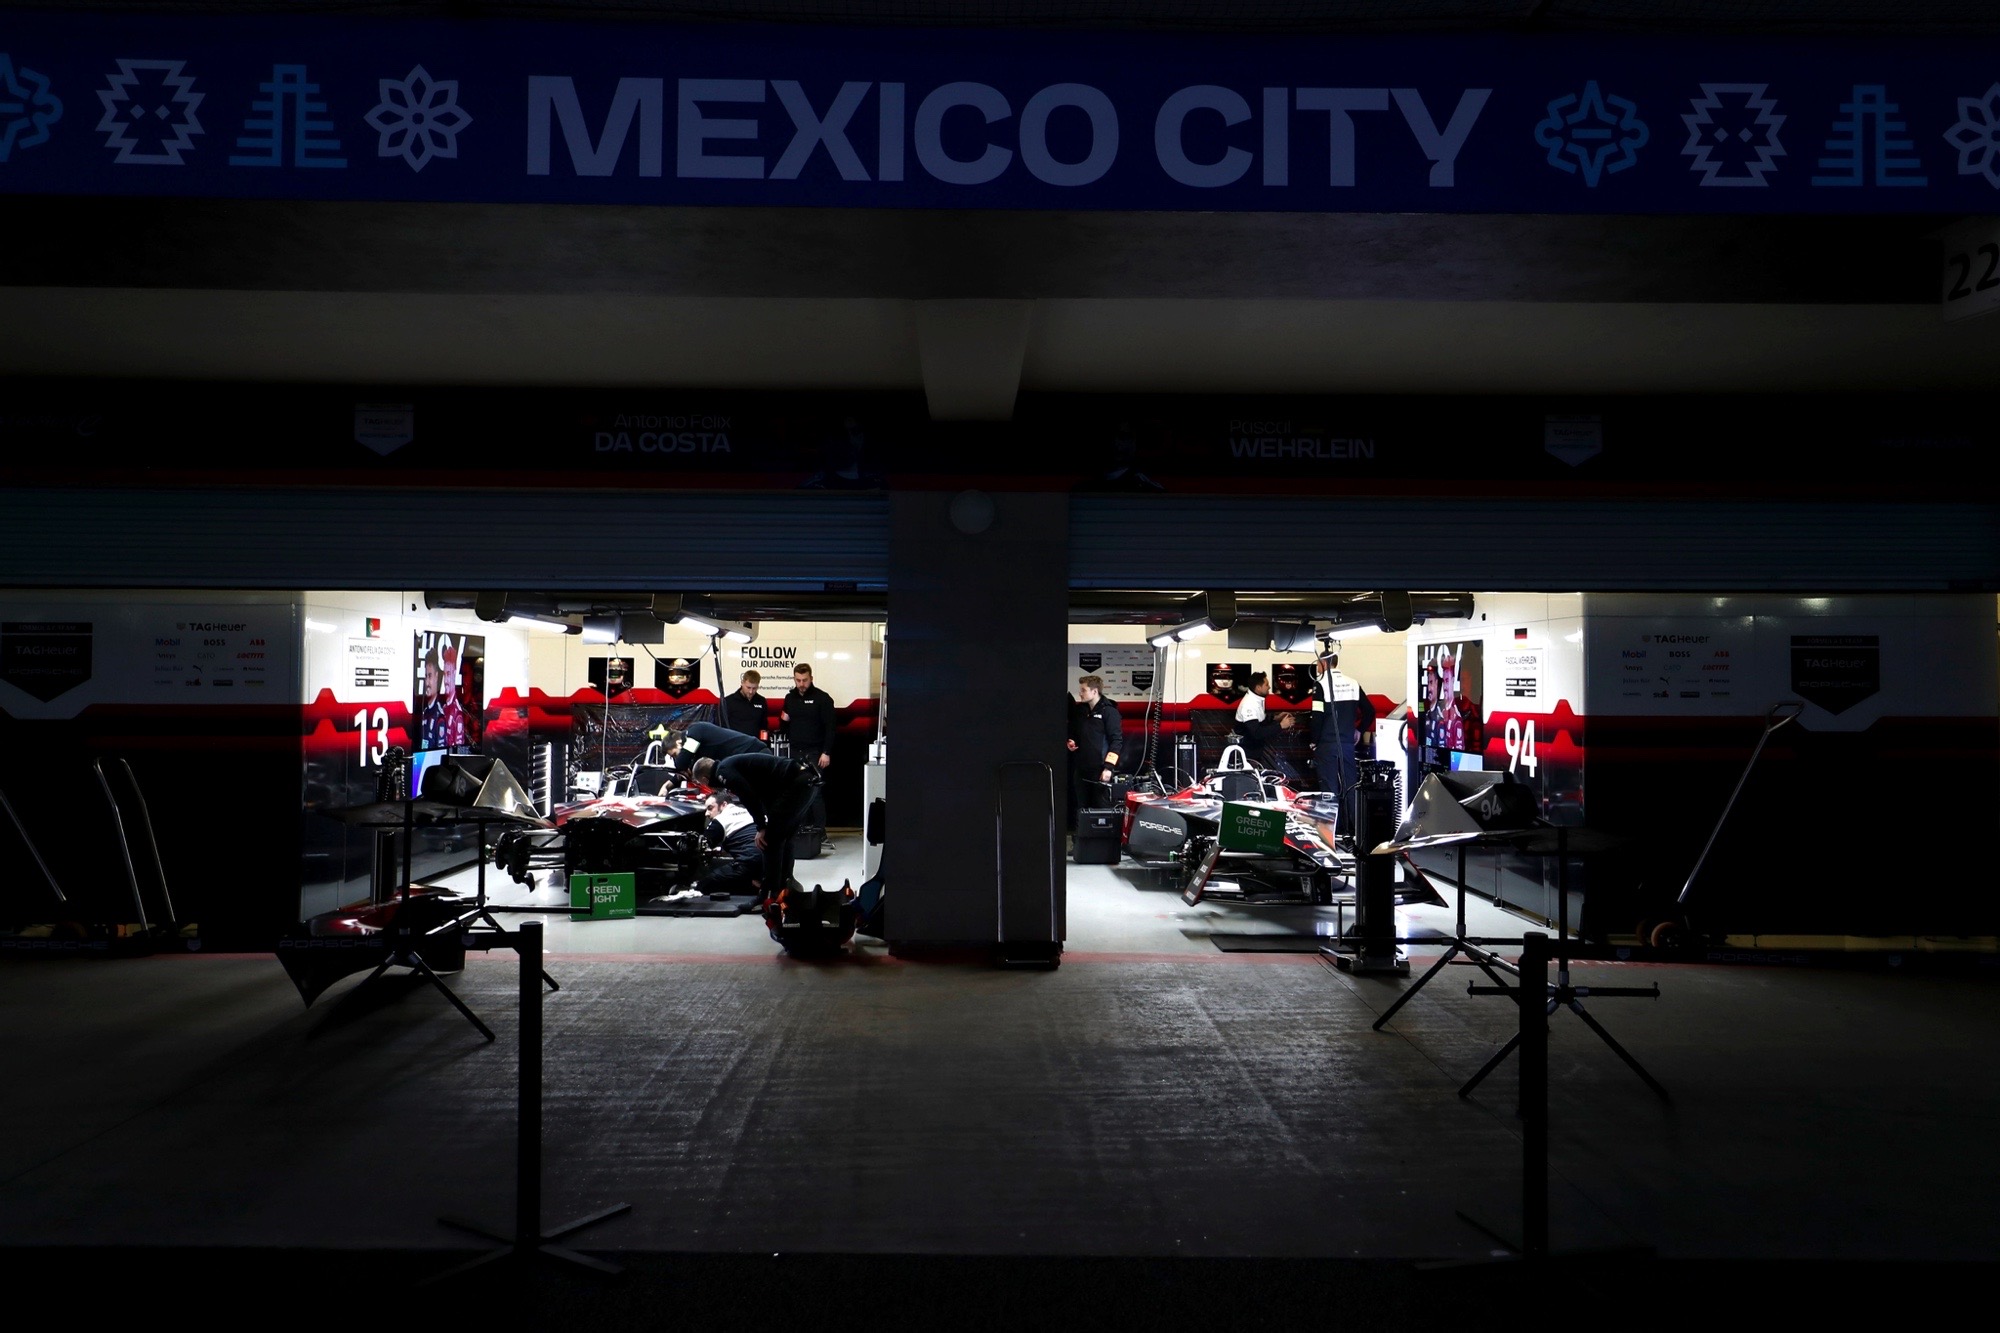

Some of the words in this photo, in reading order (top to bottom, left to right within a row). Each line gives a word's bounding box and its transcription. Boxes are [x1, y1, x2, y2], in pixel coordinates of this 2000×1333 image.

[527, 75, 1119, 186] MEXICO
[1154, 84, 1493, 188] CITY
[1947, 243, 2000, 302] 22
[595, 431, 633, 452] DA
[639, 431, 731, 453] COSTA
[1229, 437, 1376, 459] WEHRLEIN
[155, 638, 181, 647] Mobil
[741, 646, 797, 659] FOLLOW
[1622, 650, 1646, 659] Mobil
[741, 660, 758, 668] OUR
[354, 706, 389, 767] 13
[1504, 717, 1538, 778] 94
[1139, 820, 1183, 836] PORSCHE
[1235, 816, 1272, 829] GREEN
[1237, 825, 1268, 838] LIGHT
[594, 894, 618, 904] IGHT
